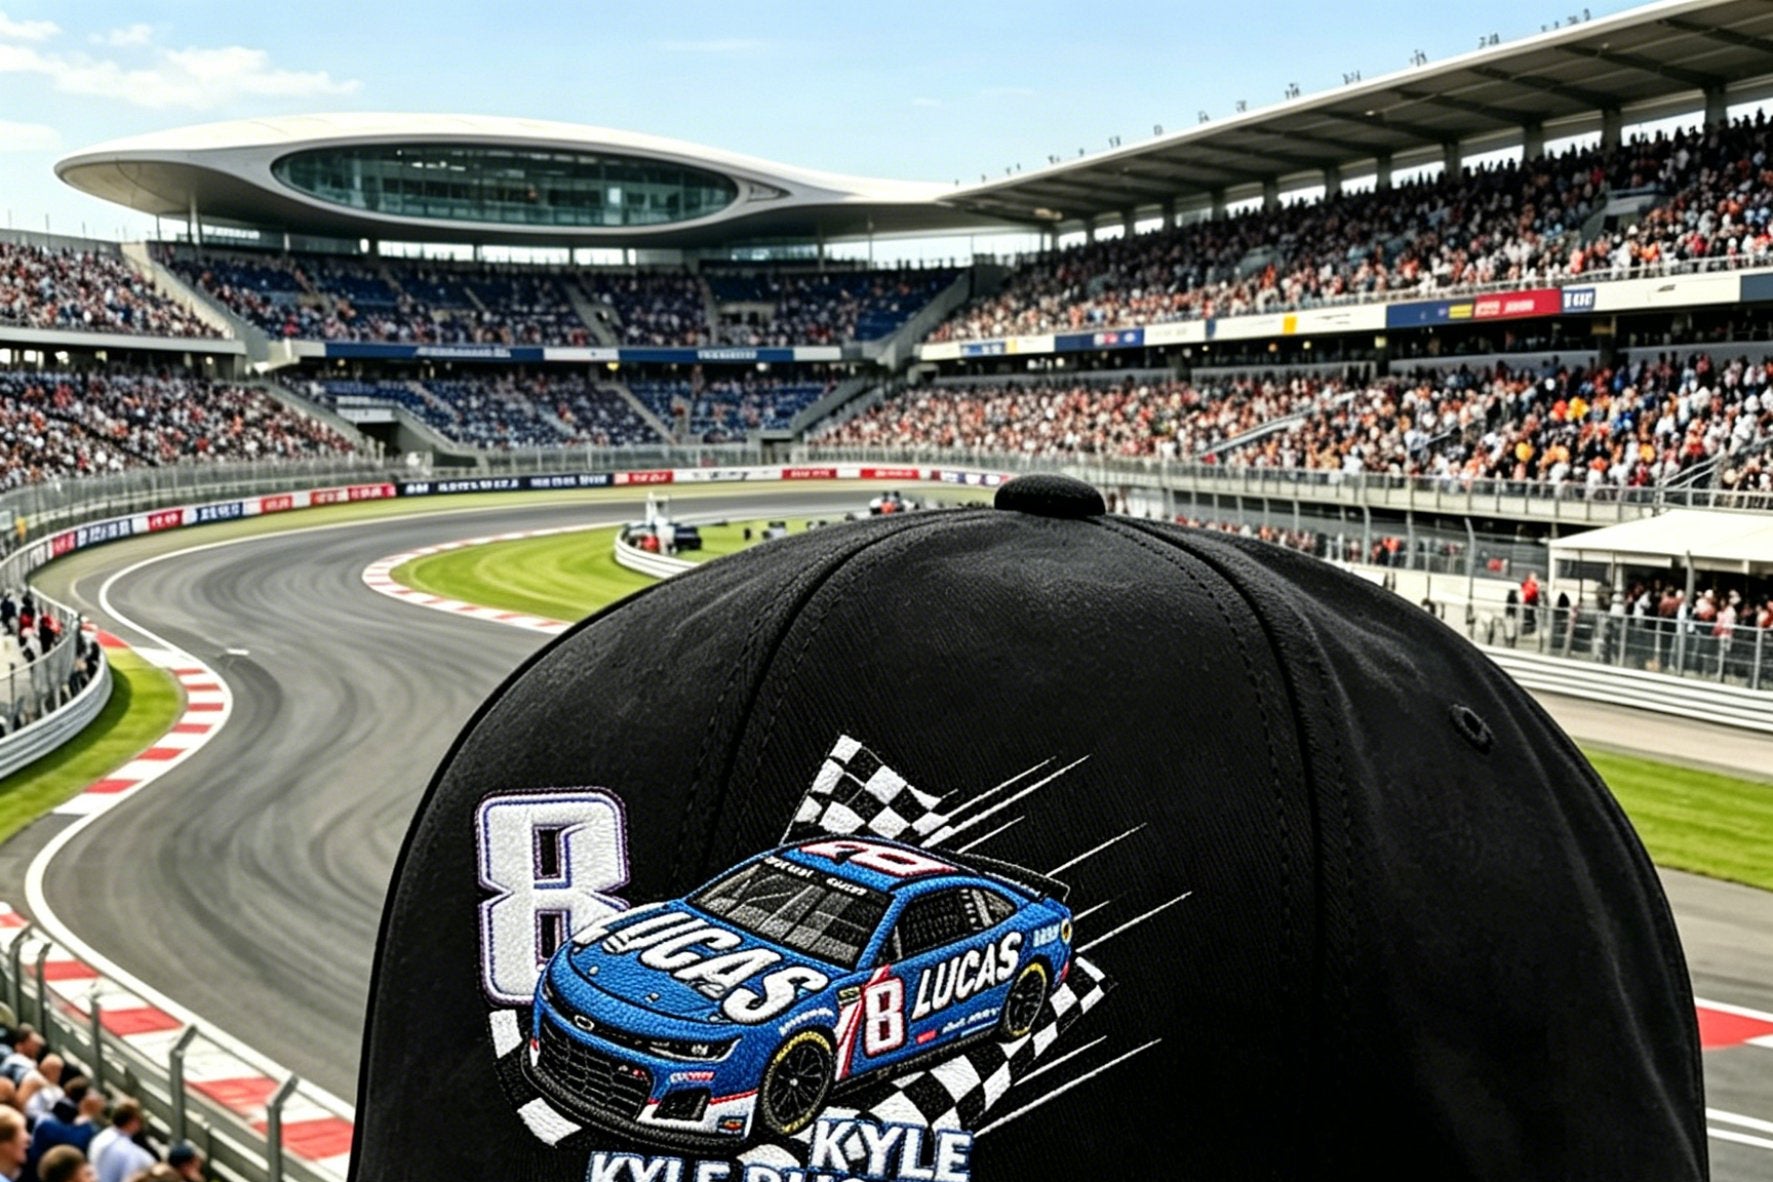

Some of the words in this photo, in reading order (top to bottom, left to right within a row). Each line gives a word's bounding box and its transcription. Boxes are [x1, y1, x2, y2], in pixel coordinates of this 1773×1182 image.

[478, 788, 630, 1006] 8
[864, 977, 904, 1056] 8
[911, 931, 1022, 1020] LUCAS
